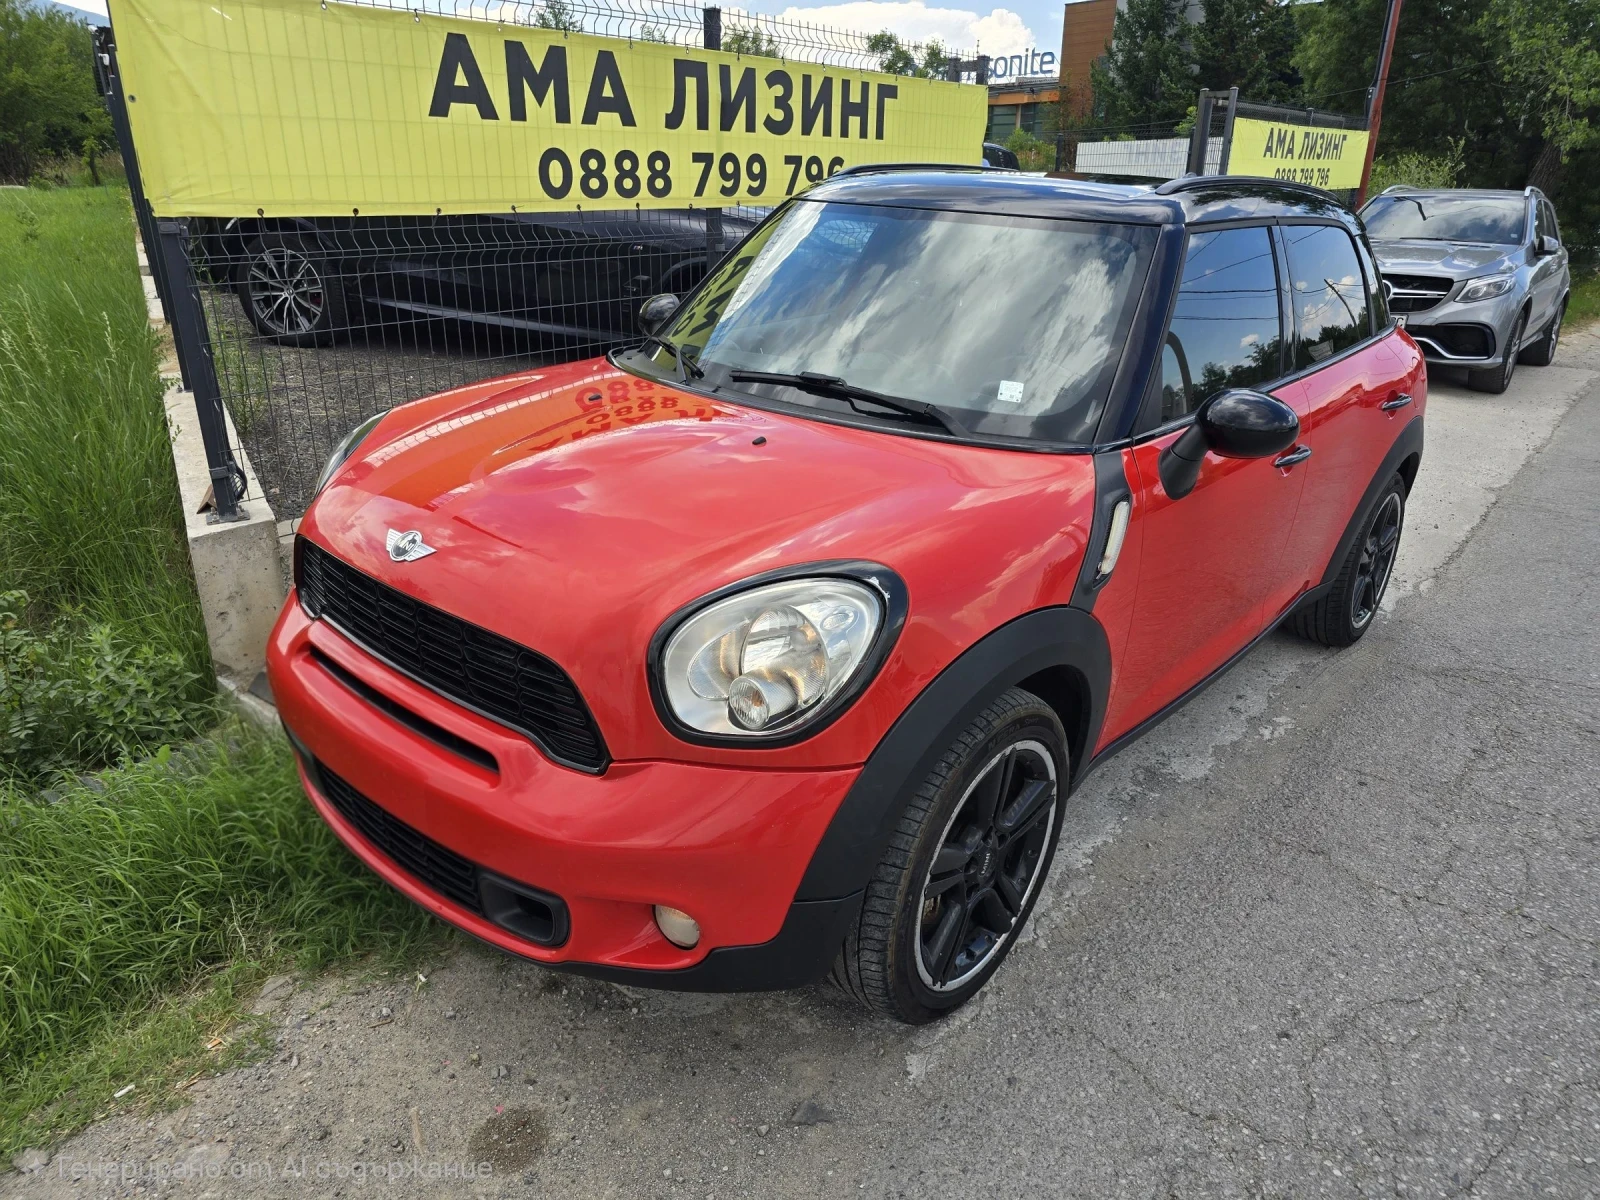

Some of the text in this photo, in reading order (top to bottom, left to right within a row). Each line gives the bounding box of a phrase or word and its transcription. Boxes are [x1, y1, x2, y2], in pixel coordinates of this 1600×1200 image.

[428, 32, 898, 140] АМА ЛИЗИНГ
[1263, 127, 1347, 160] АМА ЛИЗИНГ
[538, 147, 672, 199] 0888
[691, 152, 767, 197] 799
[1315, 168, 1330, 186] 796
